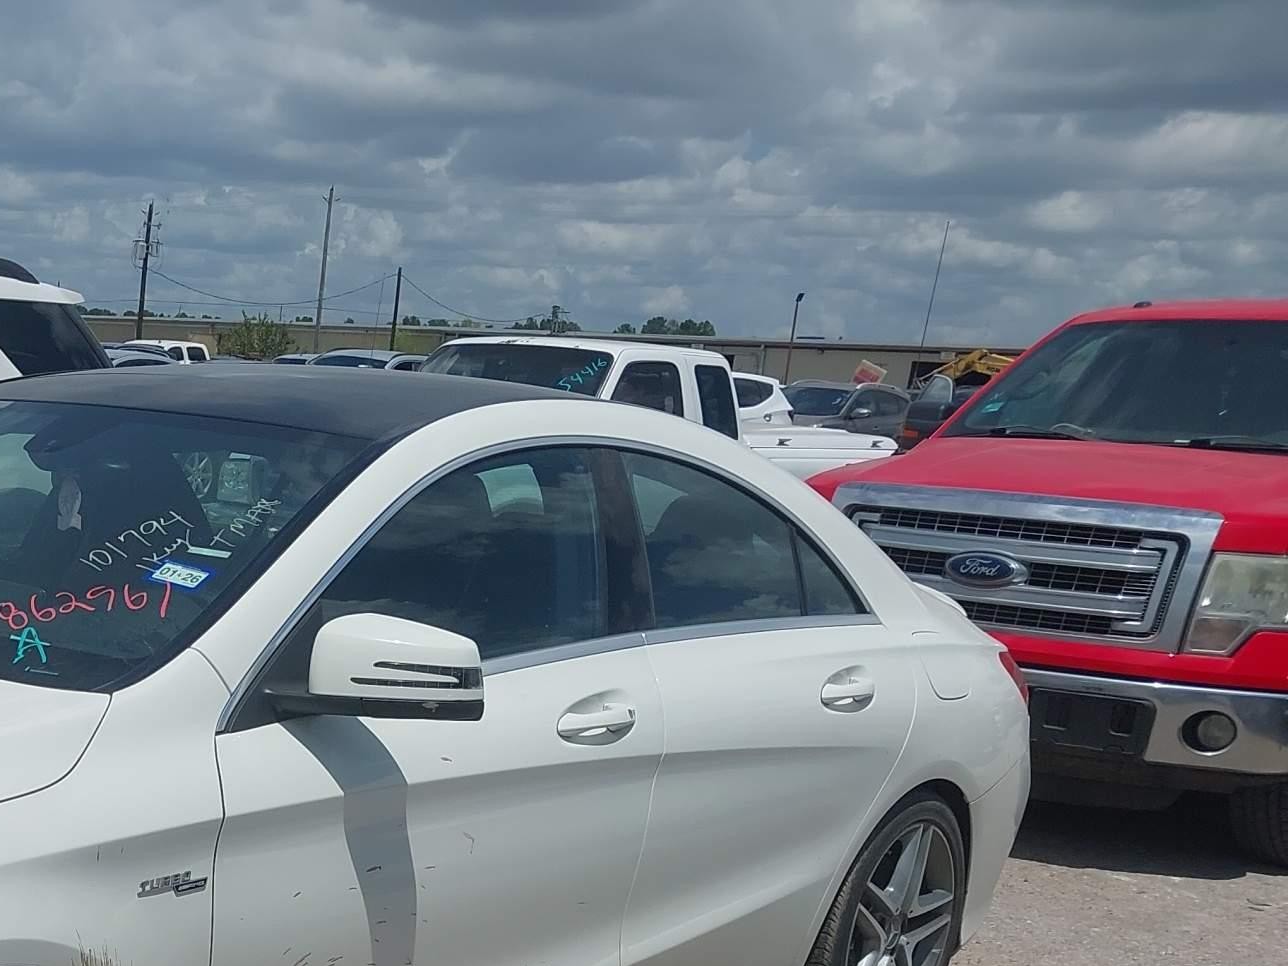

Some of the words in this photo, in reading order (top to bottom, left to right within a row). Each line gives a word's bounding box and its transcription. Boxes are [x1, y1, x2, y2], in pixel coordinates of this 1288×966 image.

[80, 511, 196, 571] 101794
[959, 558, 1001, 576] Ford
[9, 627, 52, 664] A
